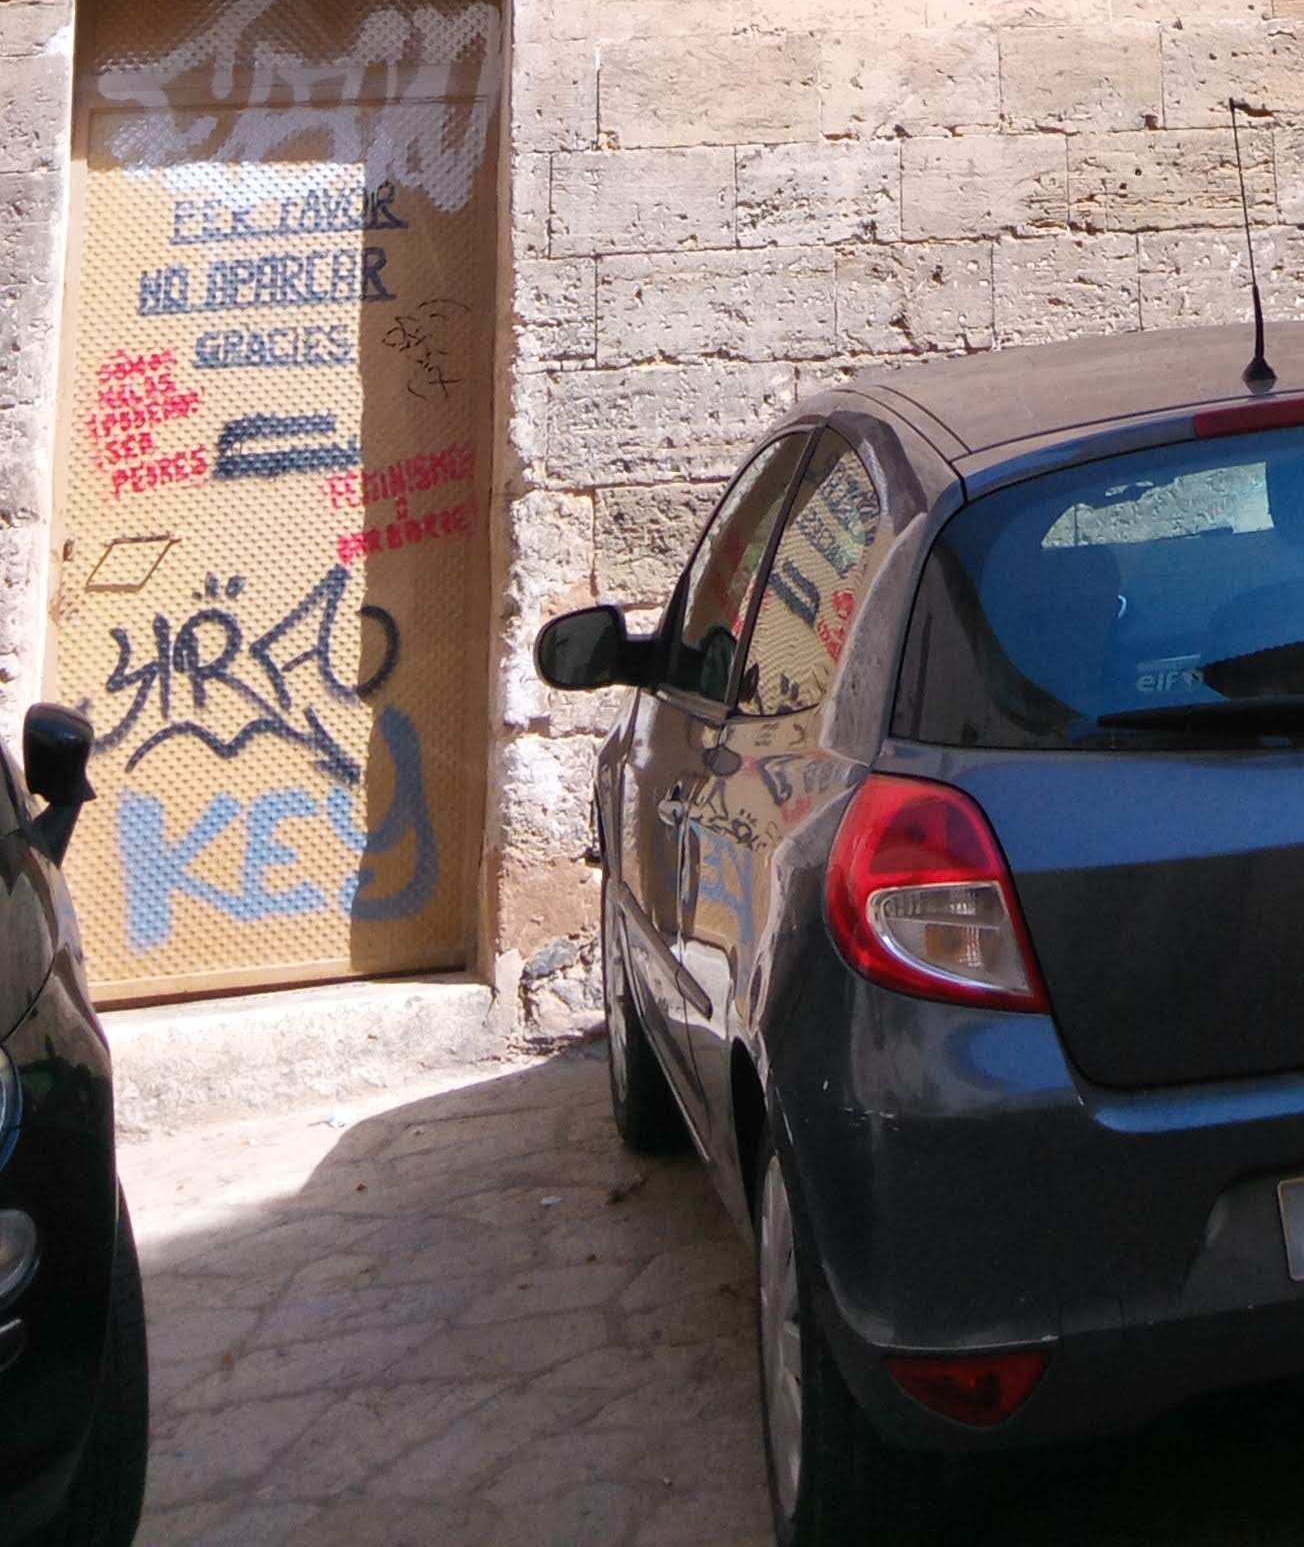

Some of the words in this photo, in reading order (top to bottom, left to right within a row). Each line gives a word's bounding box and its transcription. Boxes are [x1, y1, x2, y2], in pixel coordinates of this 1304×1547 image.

[280, 180, 406, 237] FAVOR
[139, 263, 189, 313] NO
[204, 247, 395, 307] APARCAR
[1136, 671, 1179, 691] elf
[116, 707, 440, 957] KEY
